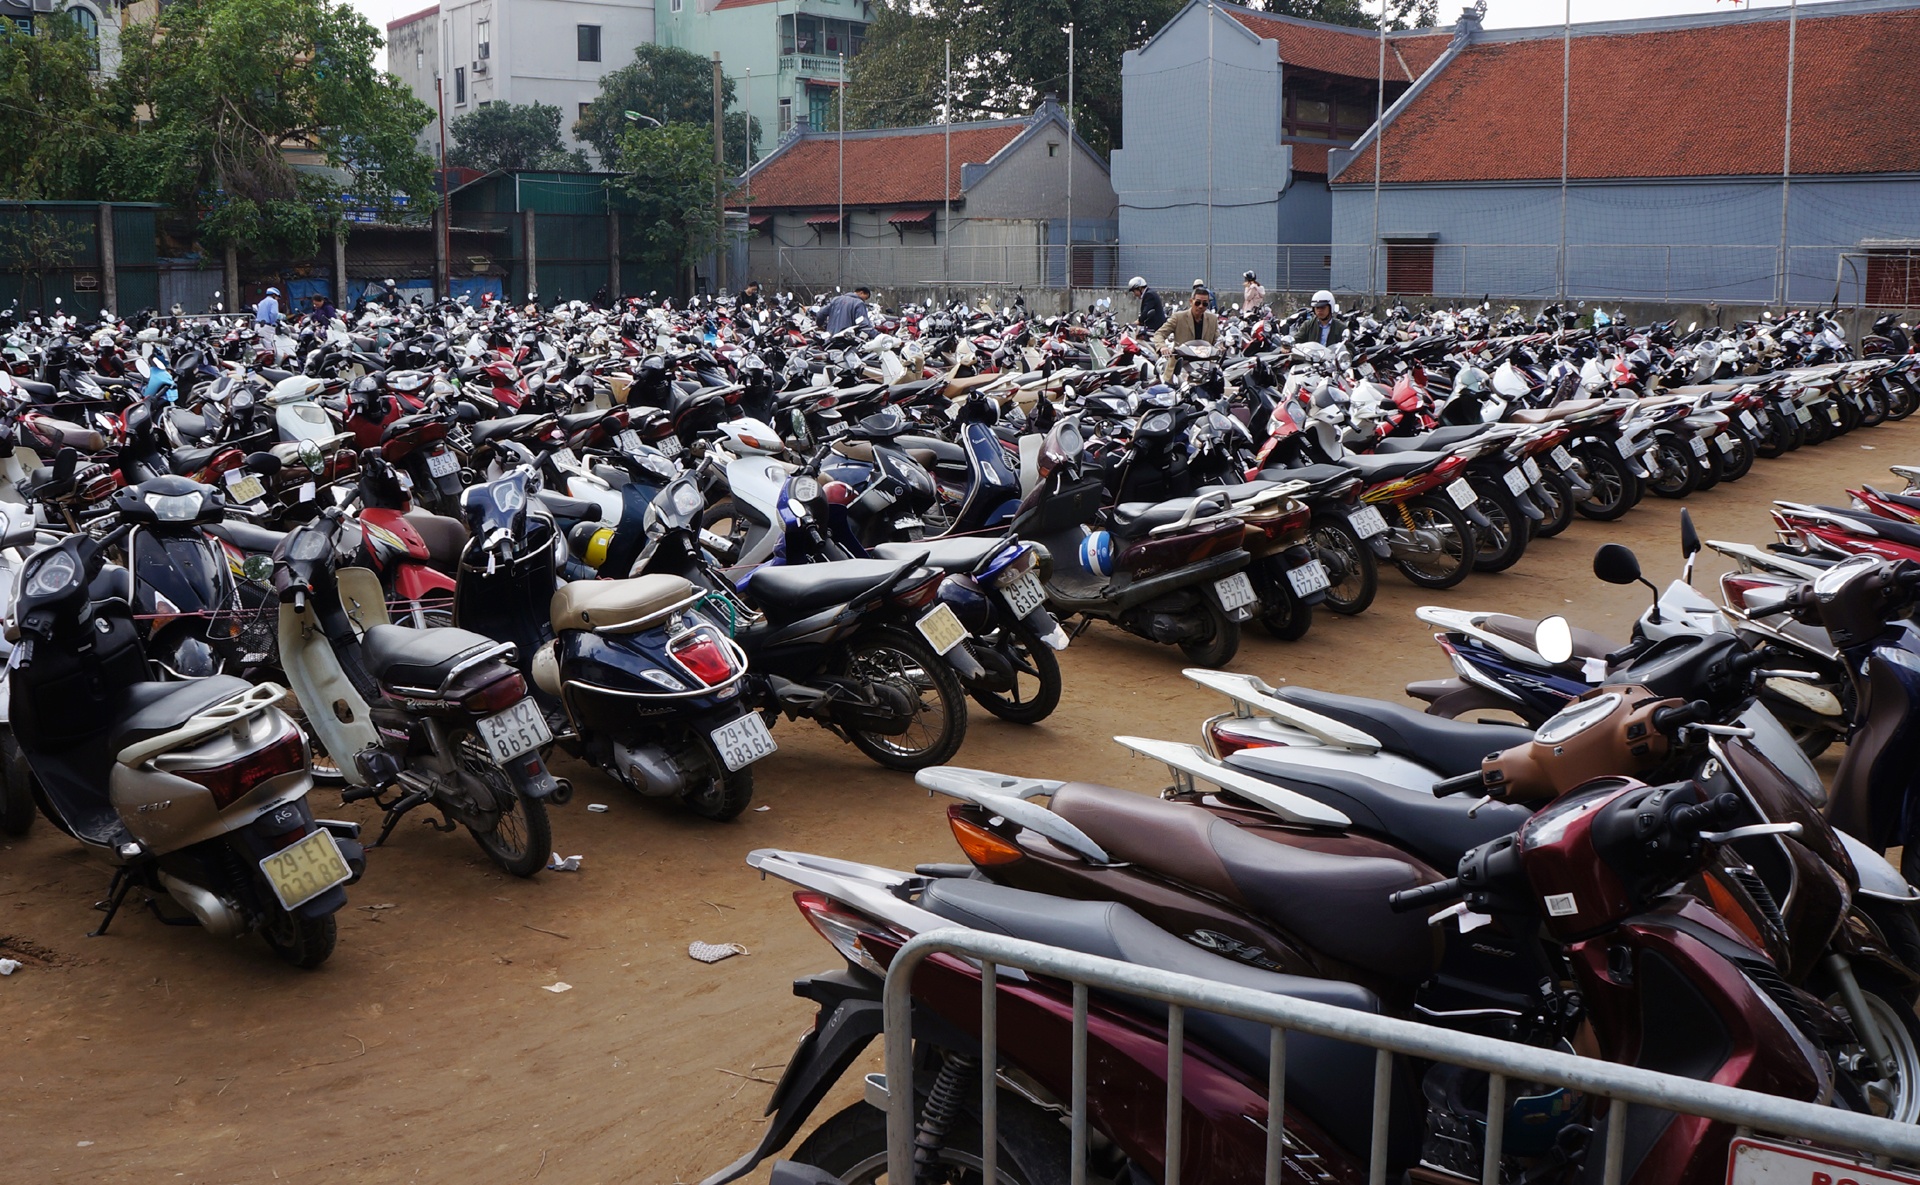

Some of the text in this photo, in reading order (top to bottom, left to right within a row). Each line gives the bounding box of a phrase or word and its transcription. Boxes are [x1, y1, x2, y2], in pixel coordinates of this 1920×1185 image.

[1352, 507, 1377, 526] 29-C1
[1358, 518, 1385, 539] 267.63
[1220, 575, 1246, 595] 53-P8
[1292, 563, 1318, 582] 29-B1
[1005, 577, 1035, 601] 29-T4
[1297, 576, 1330, 596] 177.91
[1015, 587, 1043, 614] 6364
[1226, 590, 1251, 609] 2774
[923, 609, 951, 635] 30-F5
[935, 623, 960, 649] 1589
[486, 703, 535, 740] 29-K2
[720, 717, 760, 749] 29-K1
[497, 726, 543, 758] 8651
[726, 737, 773, 768] 383.64
[275, 810, 292, 824] A6
[273, 837, 328, 880] 29-E1
